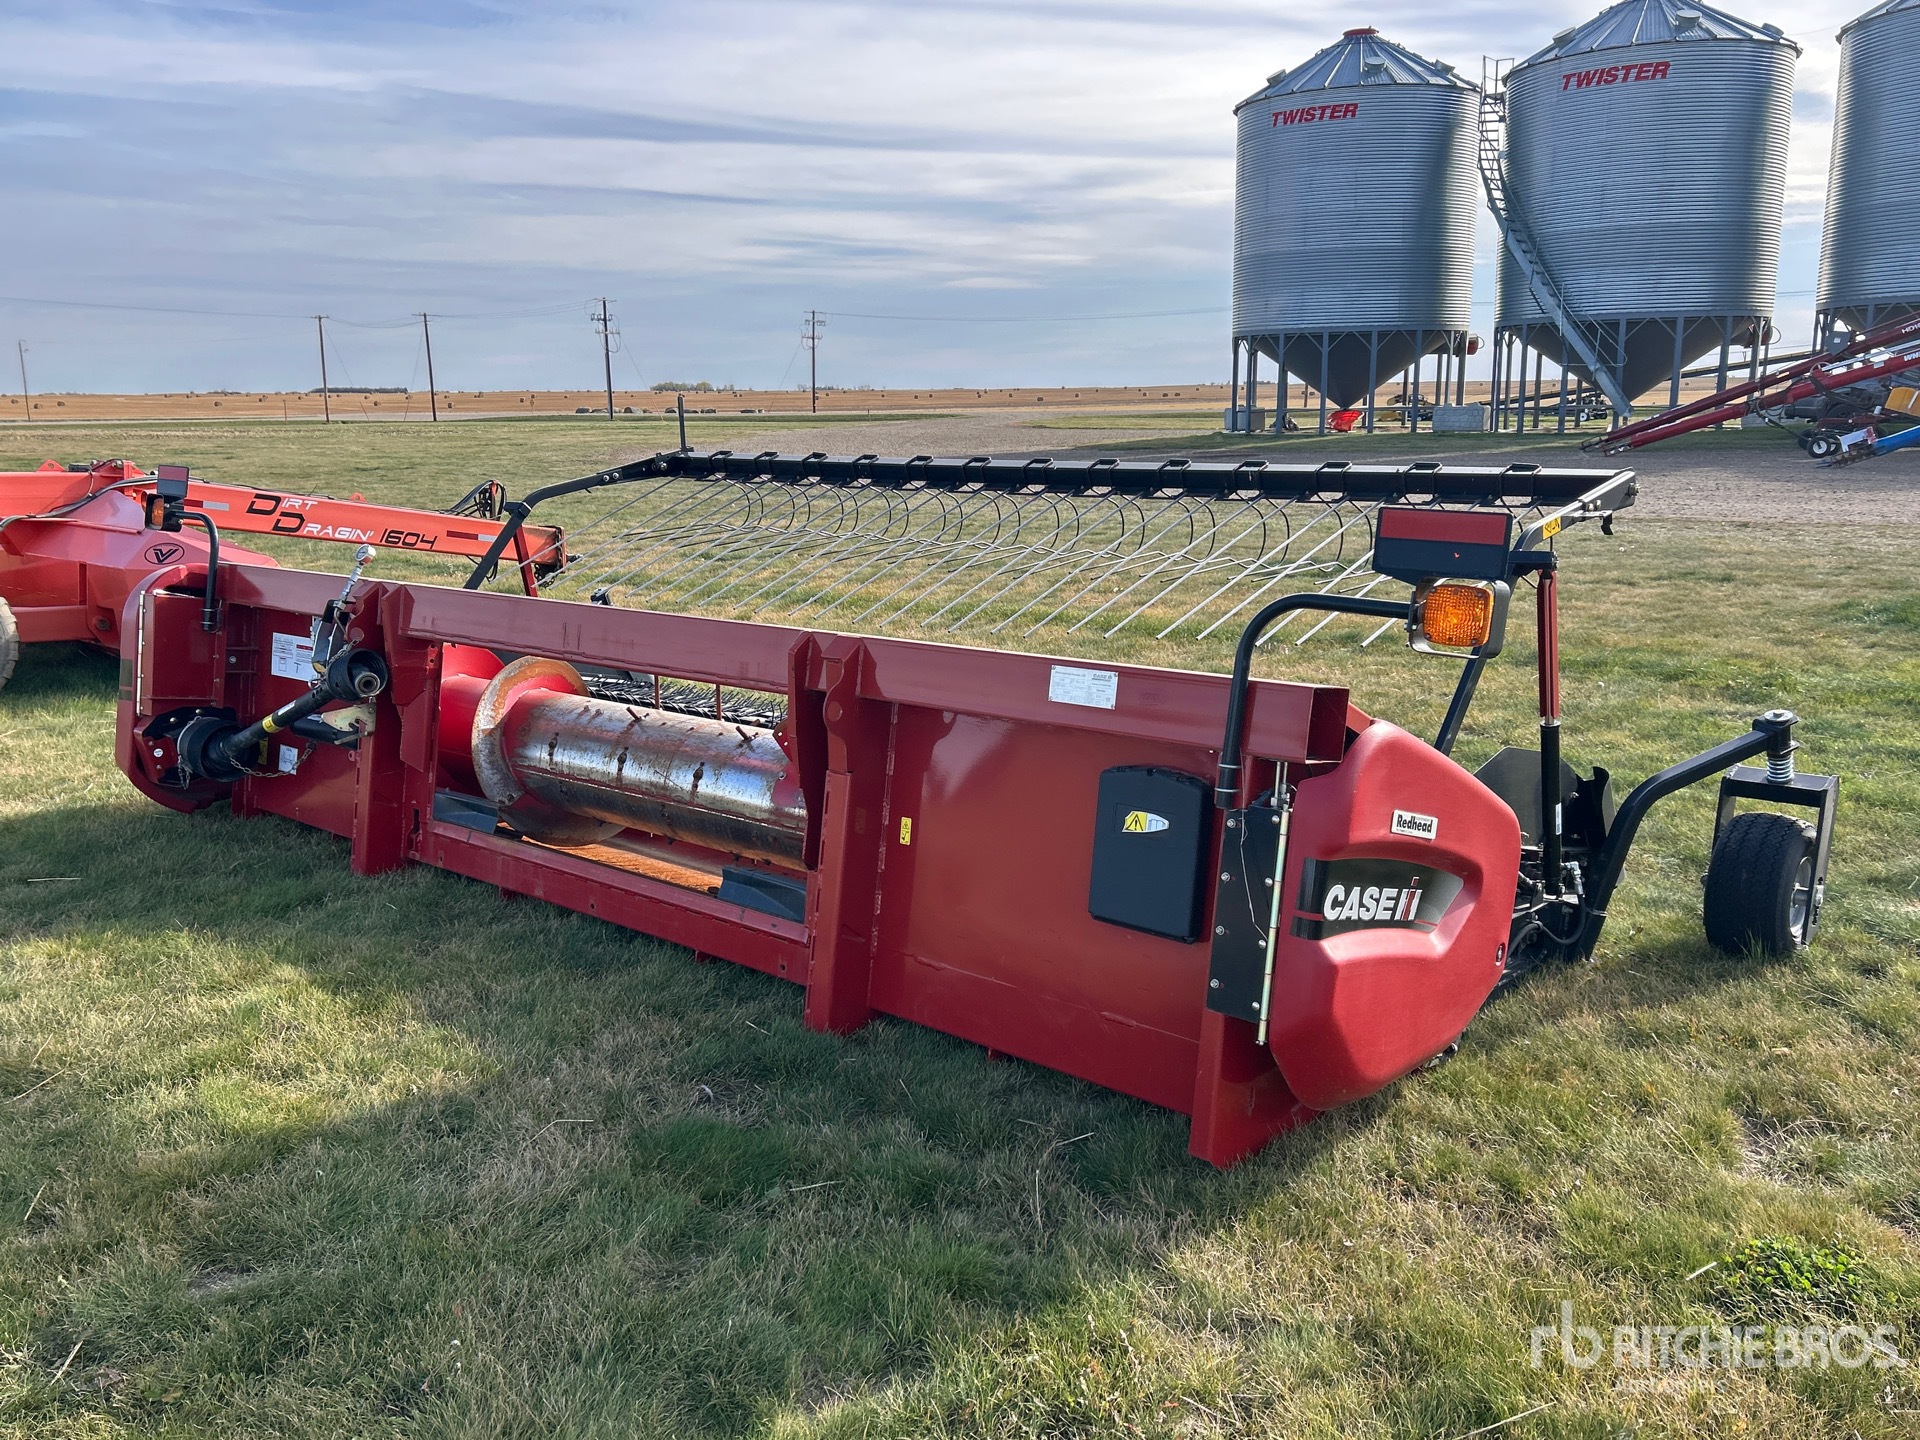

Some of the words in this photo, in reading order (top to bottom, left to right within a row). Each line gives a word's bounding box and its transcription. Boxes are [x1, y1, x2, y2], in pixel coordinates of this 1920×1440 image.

[1562, 61, 1671, 91] TWISTER
[1271, 103, 1359, 128] TWISTER
[246, 493, 318, 515] DIRT
[379, 528, 438, 549] 1604
[1396, 813, 1434, 834] Redhead
